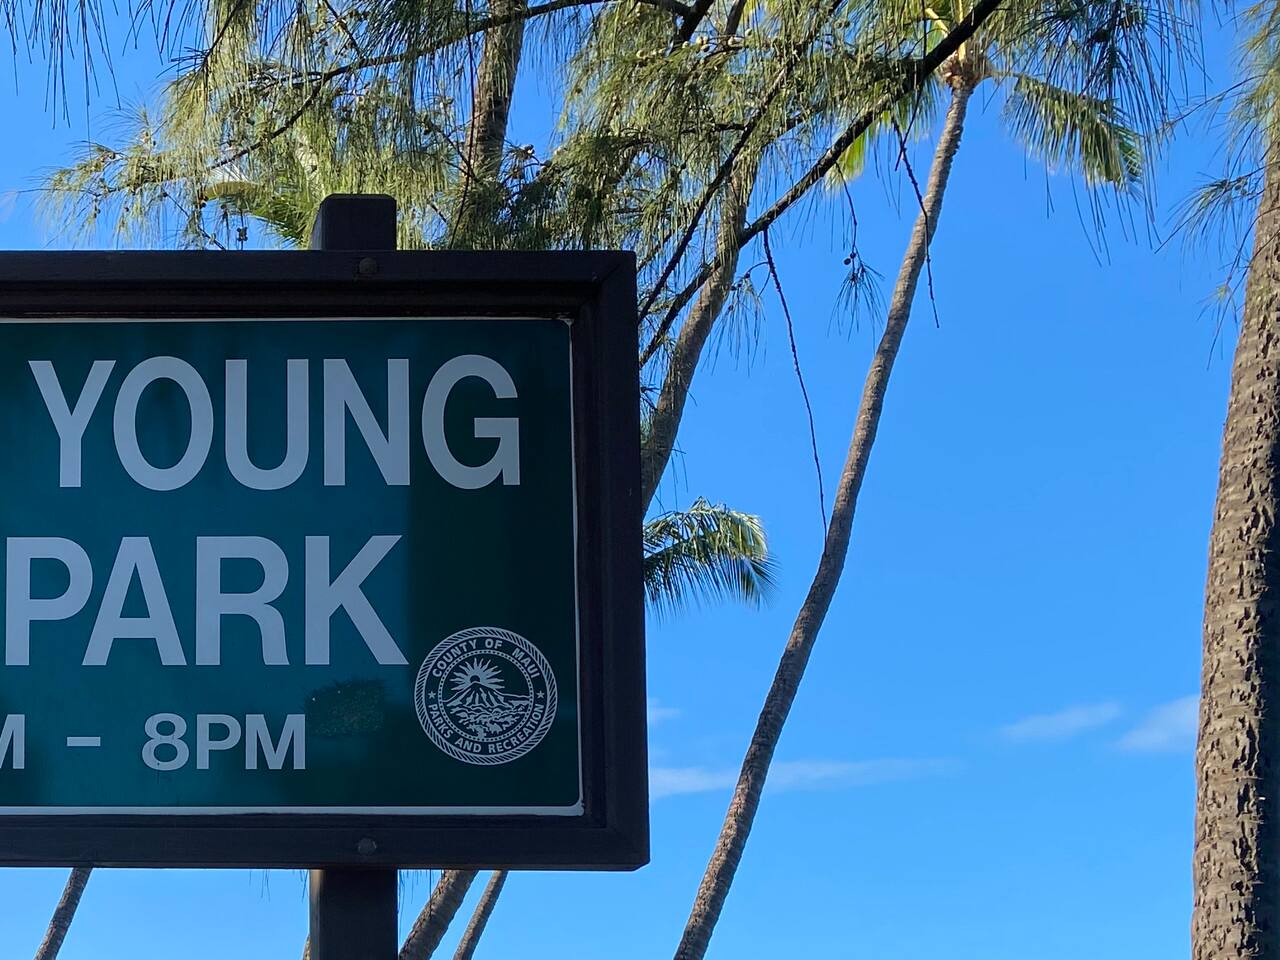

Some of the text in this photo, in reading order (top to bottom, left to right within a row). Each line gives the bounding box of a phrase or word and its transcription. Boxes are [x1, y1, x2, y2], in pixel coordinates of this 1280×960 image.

[29, 354, 521, 491] YOUNG
[5, 534, 410, 667] PARK
[432, 638, 541, 679] COUNTY OF MAUI
[141, 712, 306, 771] 8PM
[428, 703, 545, 754] PARKS AND RECREATION
